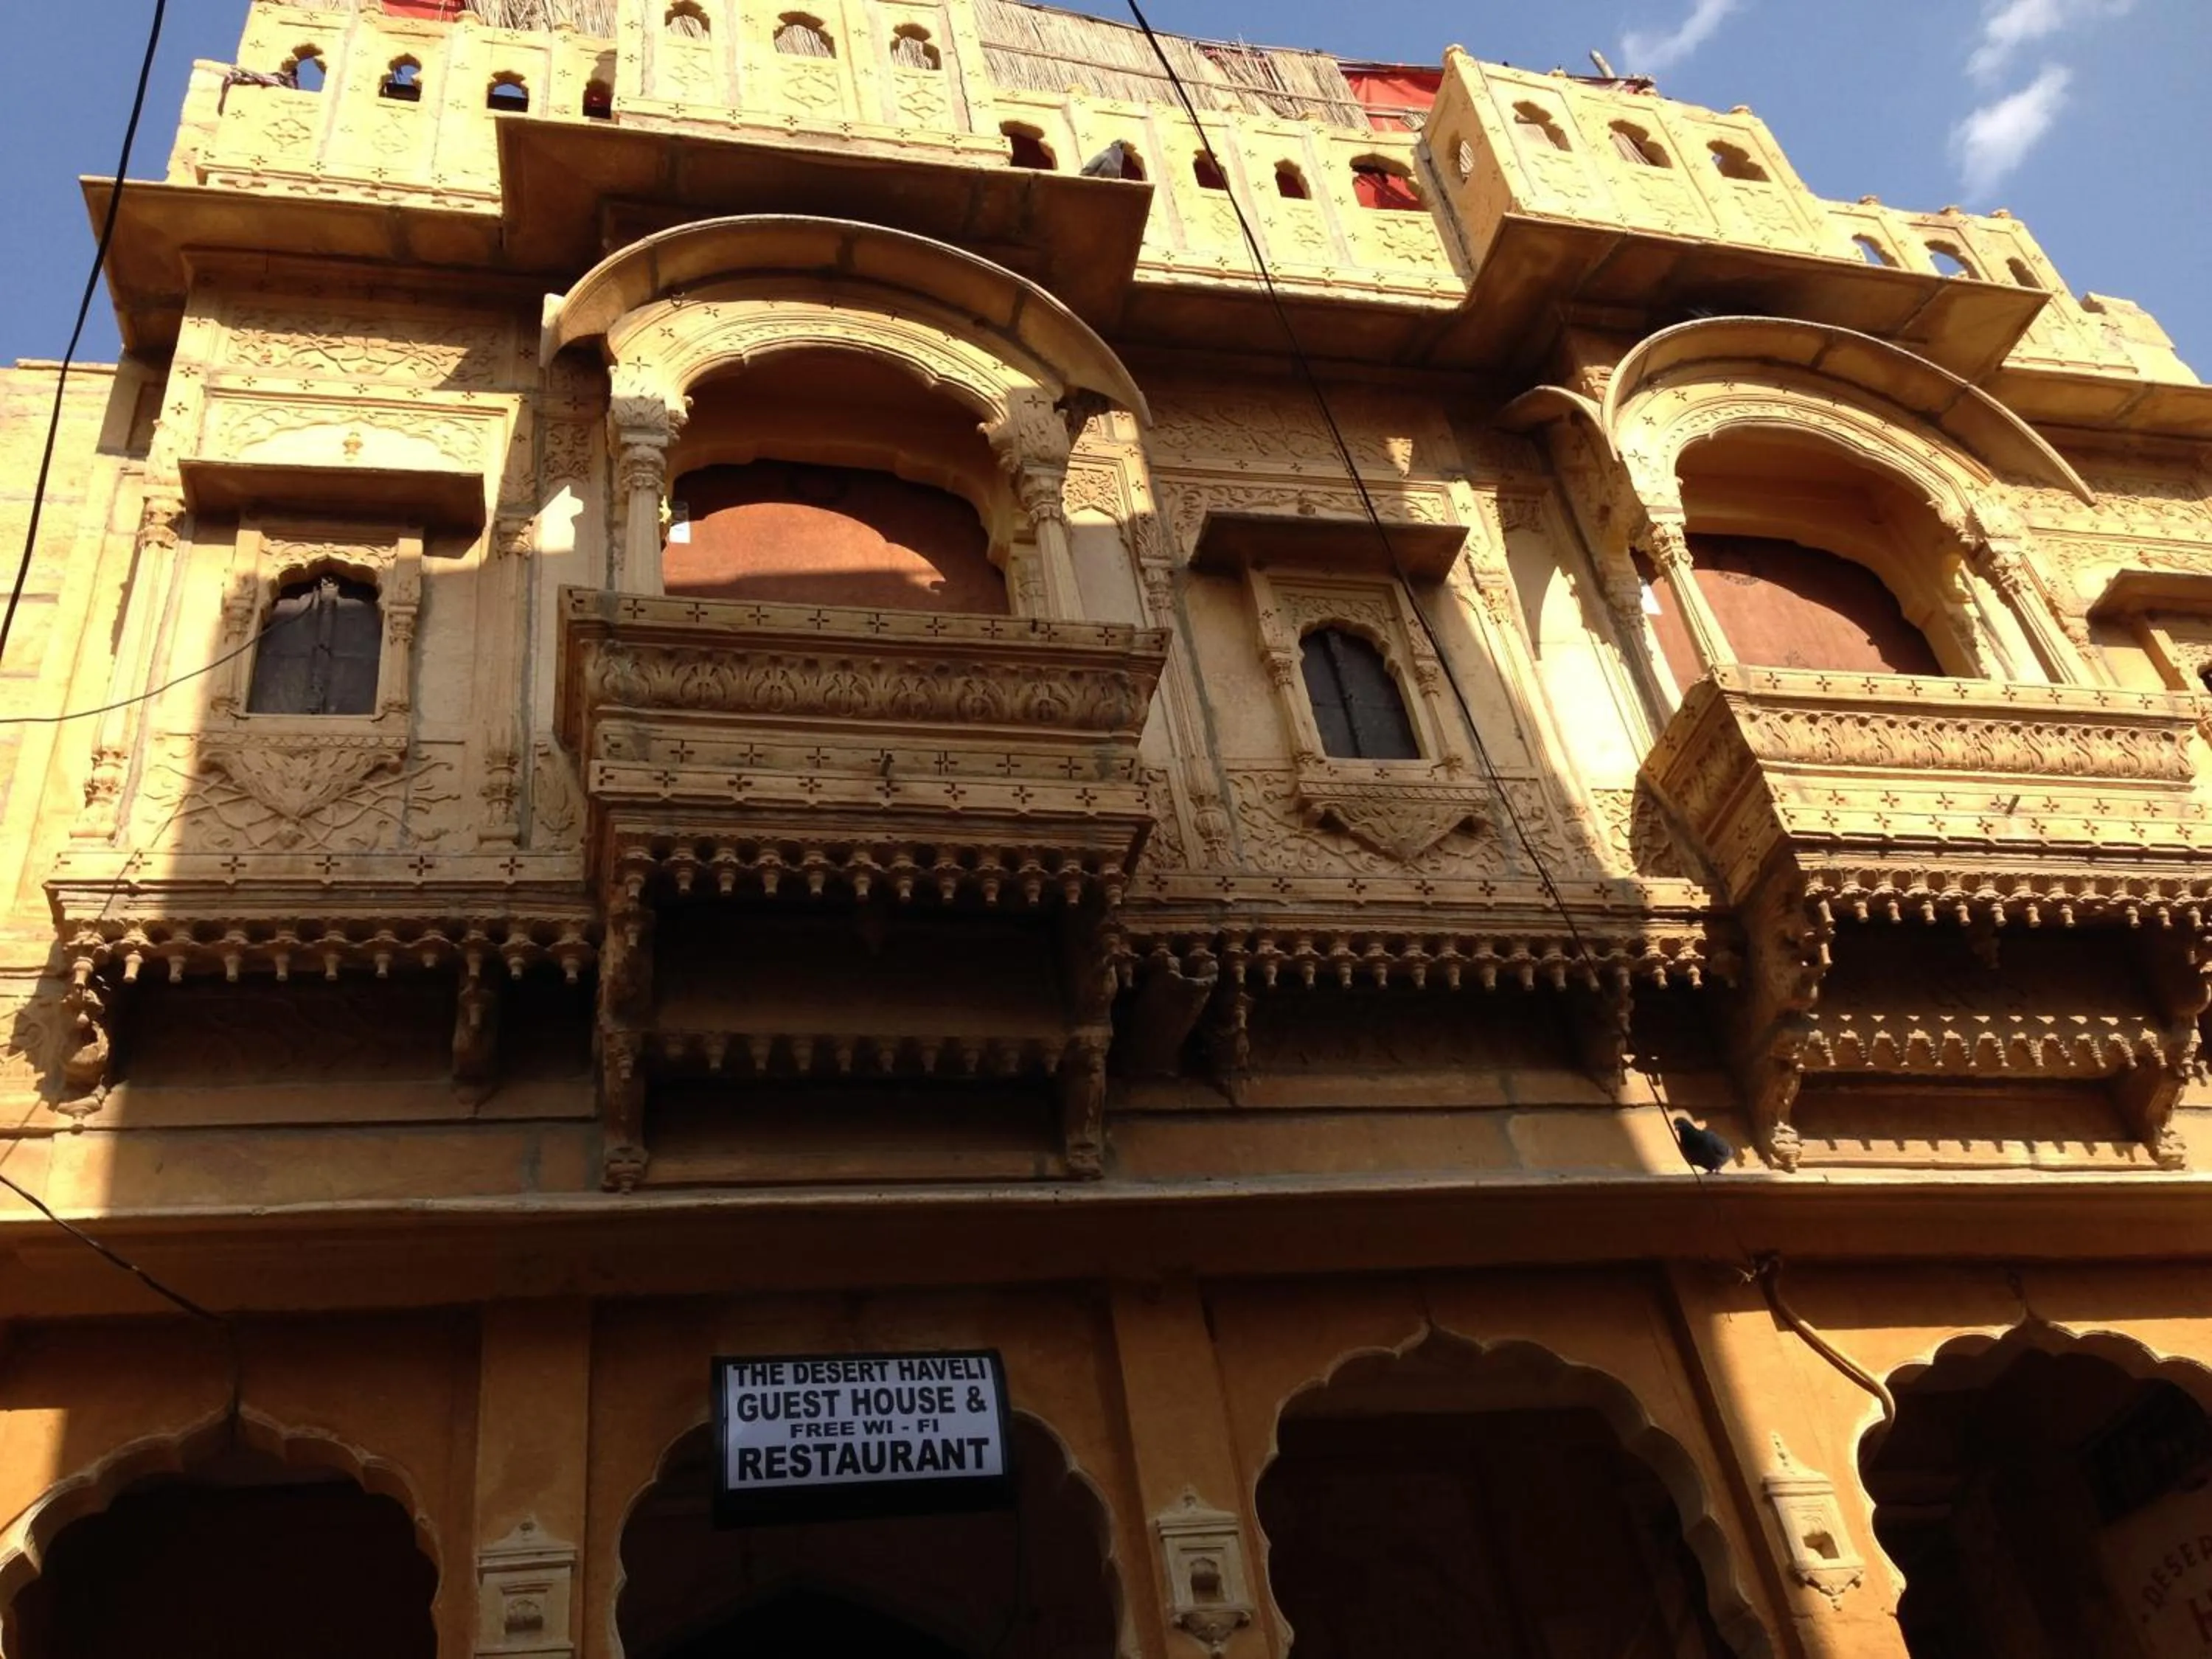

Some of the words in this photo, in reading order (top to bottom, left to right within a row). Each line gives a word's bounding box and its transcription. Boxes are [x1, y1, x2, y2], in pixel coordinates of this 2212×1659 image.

[734, 1363, 785, 1387] THE
[793, 1361, 888, 1385] DESERT
[899, 1357, 986, 1381] HAVELI
[737, 1390, 841, 1422] GUEST
[852, 1387, 956, 1416] HOUSE
[967, 1385, 987, 1413] &
[790, 1421, 855, 1438] FREE
[738, 1438, 990, 1481] RESTAURANT
